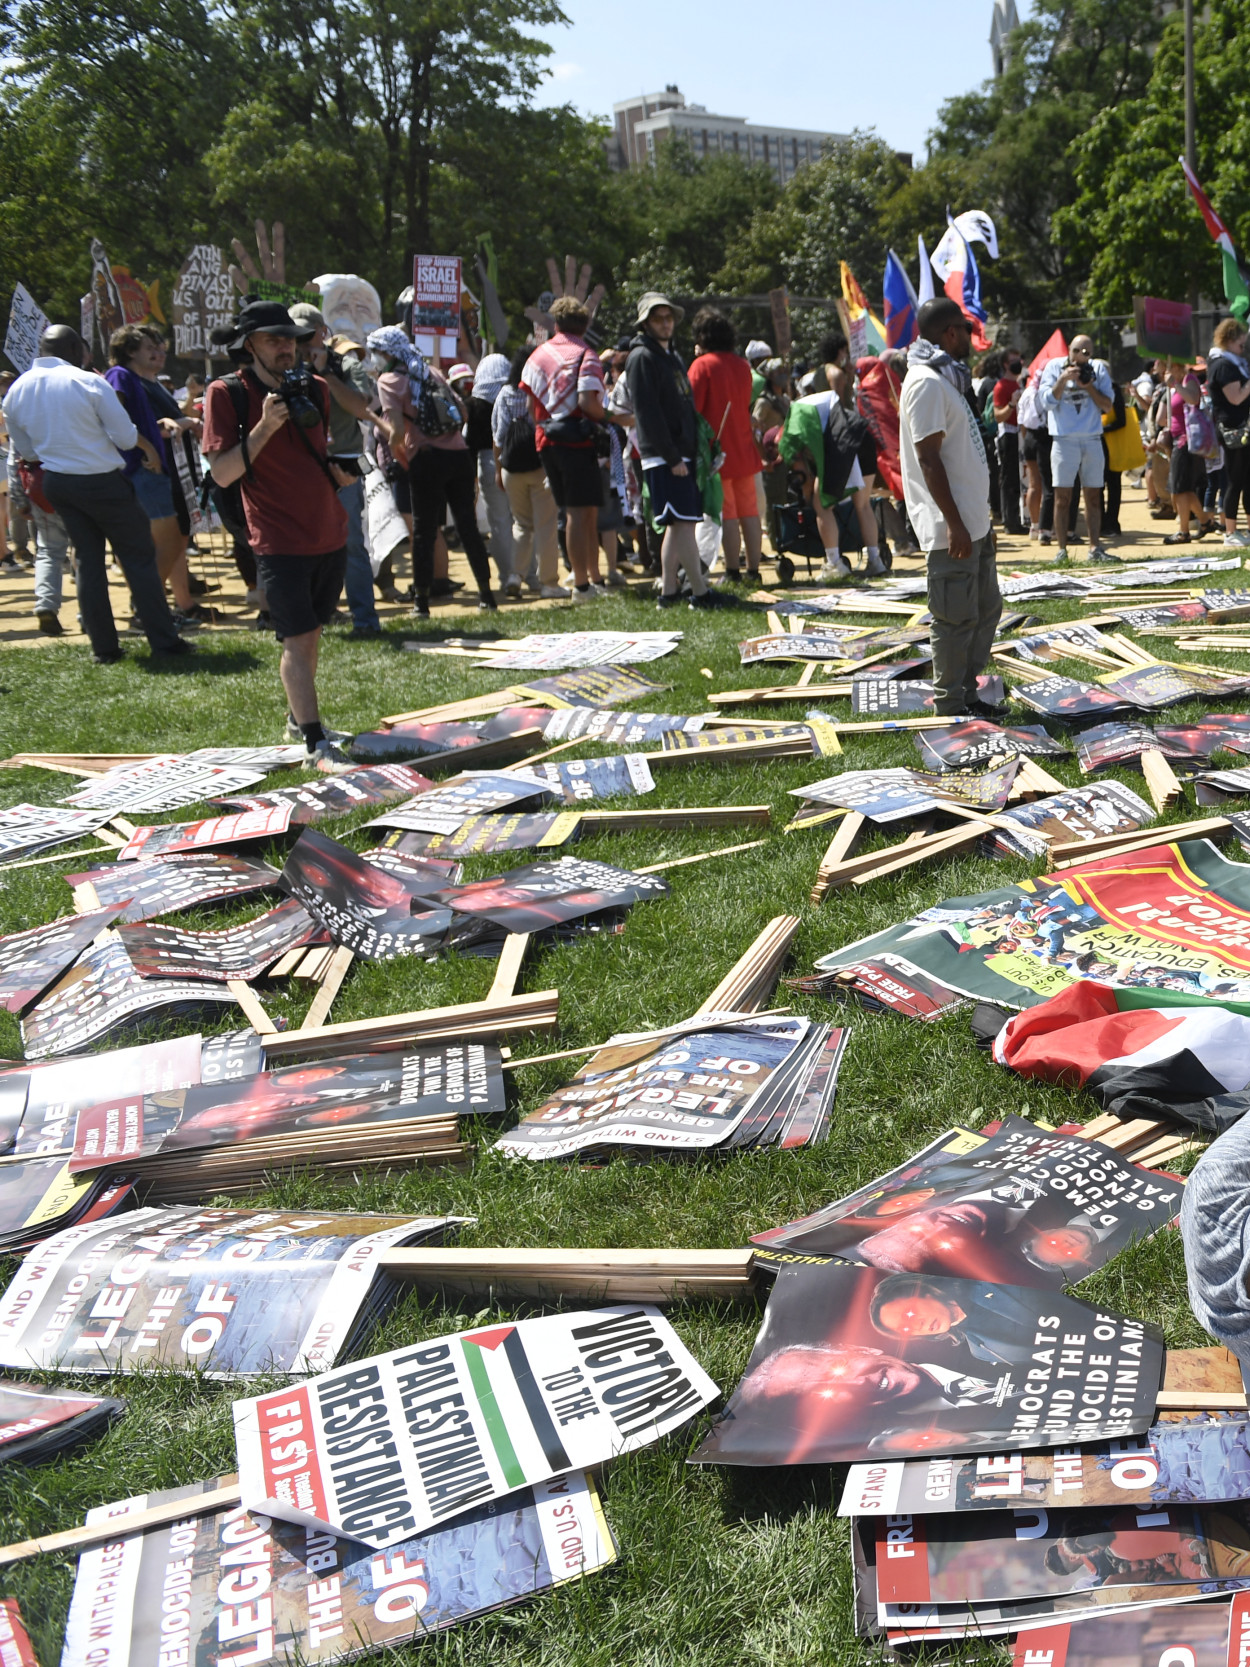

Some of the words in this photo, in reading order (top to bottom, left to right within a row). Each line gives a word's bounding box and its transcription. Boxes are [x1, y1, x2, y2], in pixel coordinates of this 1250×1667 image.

[186, 262, 222, 276] ANG
[418, 267, 457, 283] ISRAEL
[184, 313, 200, 326] OF
[205, 295, 234, 310] OUT
[1033, 799, 1097, 842] GAZA
[877, 977, 916, 1001] FREE
[766, 1024, 798, 1037] END
[688, 1073, 746, 1092] THE
[697, 1055, 761, 1076] OF
[643, 1132, 706, 1145] STAND
[994, 1143, 1029, 1152] OF
[1000, 1153, 1047, 1165] THE
[1005, 1132, 1178, 1204] PALESTINIANS
[1033, 1147, 1156, 1211] GENOCIDE
[1054, 1164, 1120, 1209] FUND
[972, 1159, 1120, 1227] DEMOCRATS
[130, 1284, 184, 1354] THE
[179, 1278, 243, 1356] OF
[1094, 1313, 1120, 1339] OF
[307, 1320, 336, 1361] END
[1058, 1334, 1087, 1372] THE
[541, 1366, 586, 1392] TO
[570, 1308, 704, 1440] VICTORY
[1006, 1316, 1062, 1441] DEMOCRATS
[1105, 1317, 1145, 1437] ALESTINIANS
[550, 1393, 602, 1428] THE
[392, 1343, 496, 1520] PALESTINIAN
[315, 1364, 419, 1542] RESISTANCE
[859, 1466, 889, 1509] STAND
[564, 1538, 586, 1570] END
[371, 1551, 430, 1625] OF
[91, 1603, 119, 1645] WITH
[157, 1563, 197, 1667] ENOCIDE
[305, 1577, 345, 1649] THE
